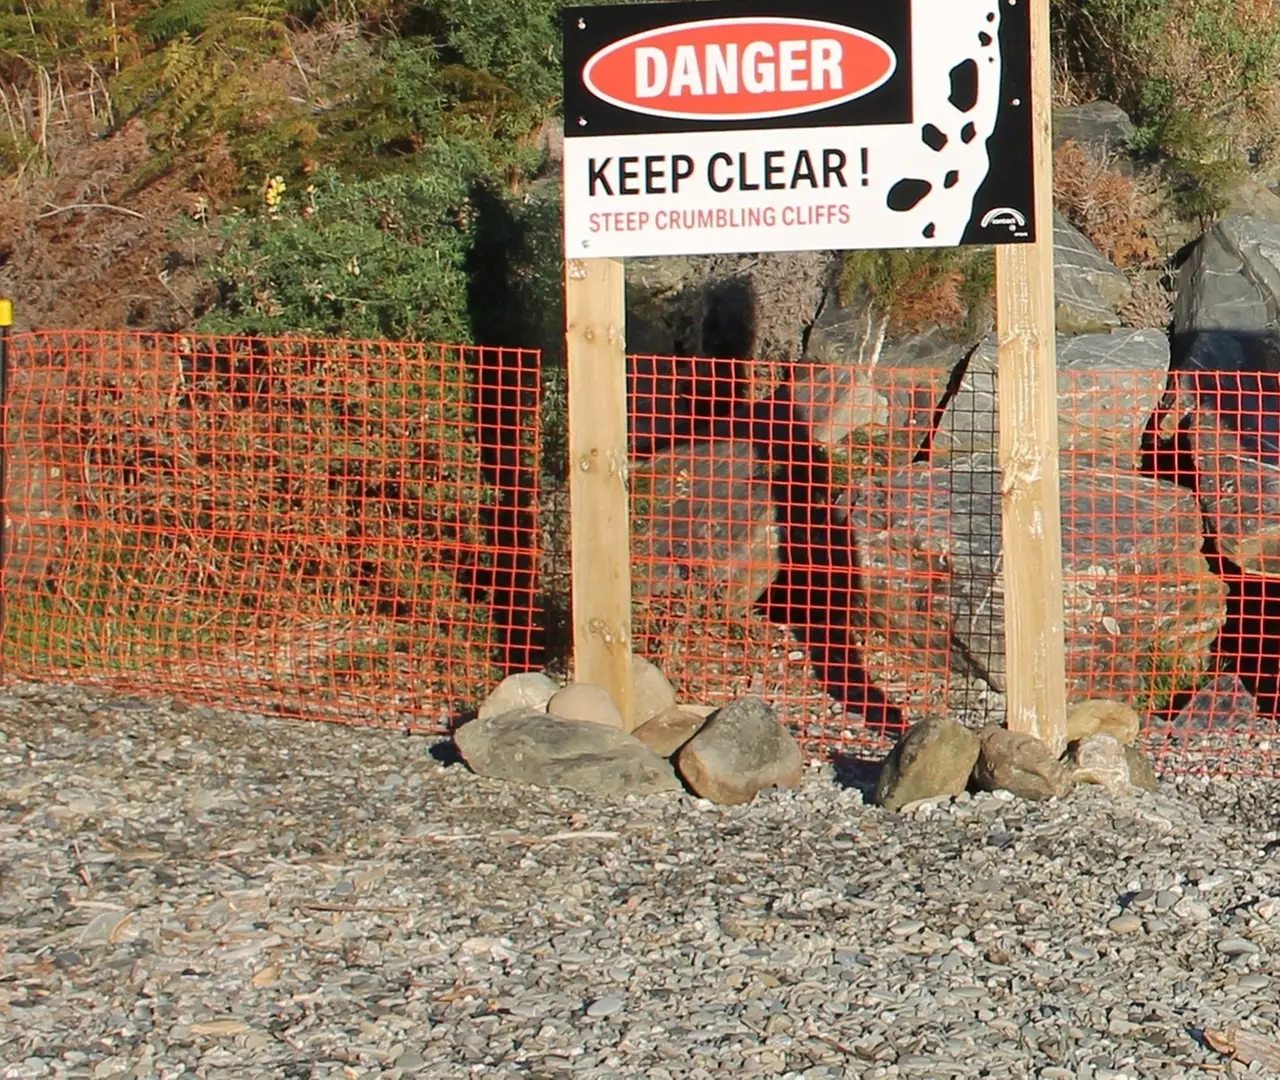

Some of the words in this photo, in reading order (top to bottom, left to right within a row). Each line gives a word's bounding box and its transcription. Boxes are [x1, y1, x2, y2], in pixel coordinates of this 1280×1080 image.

[634, 38, 843, 98] DANGER
[588, 153, 695, 196] KEEP
[588, 211, 649, 233] STEEP
[655, 206, 776, 230] CRUMBLING
[782, 204, 851, 226] CLIFFS
